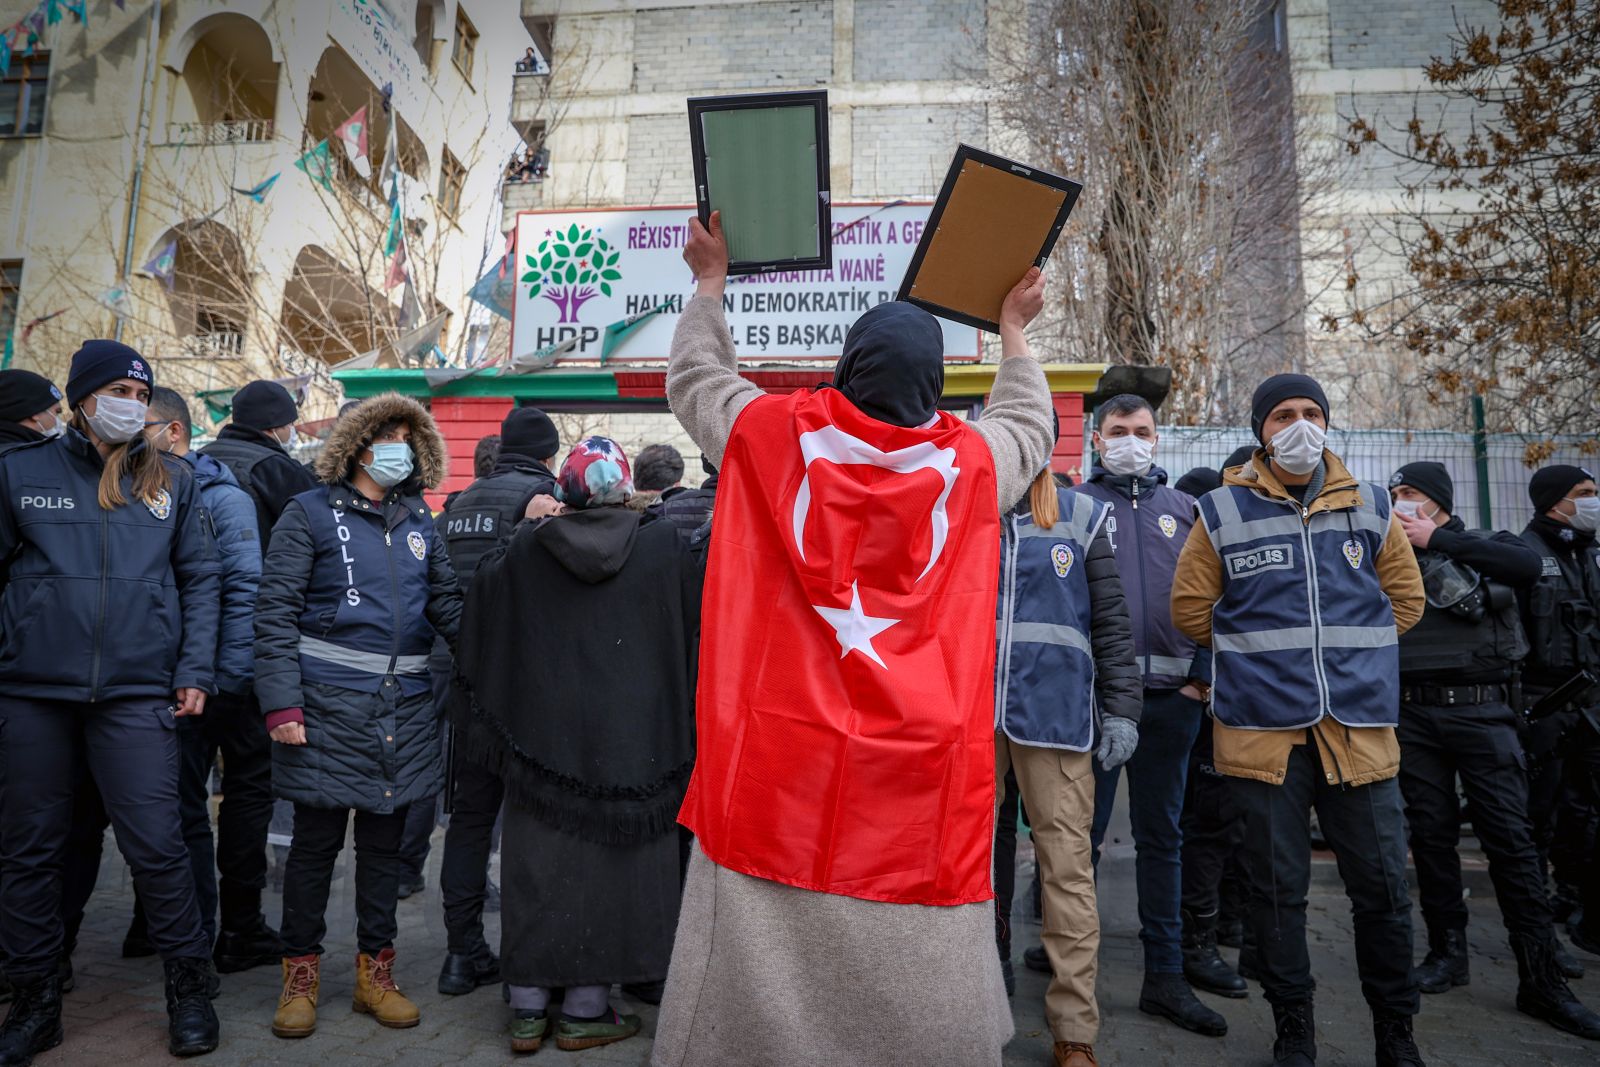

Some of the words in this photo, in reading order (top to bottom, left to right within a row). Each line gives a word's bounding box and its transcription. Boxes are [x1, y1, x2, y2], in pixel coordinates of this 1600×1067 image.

[887, 221, 897, 244] A
[839, 253, 885, 282] WANÊ
[742, 286, 870, 312] DEMOKRATİK
[537, 326, 599, 353] HDP
[746, 325, 770, 351] EŞ
